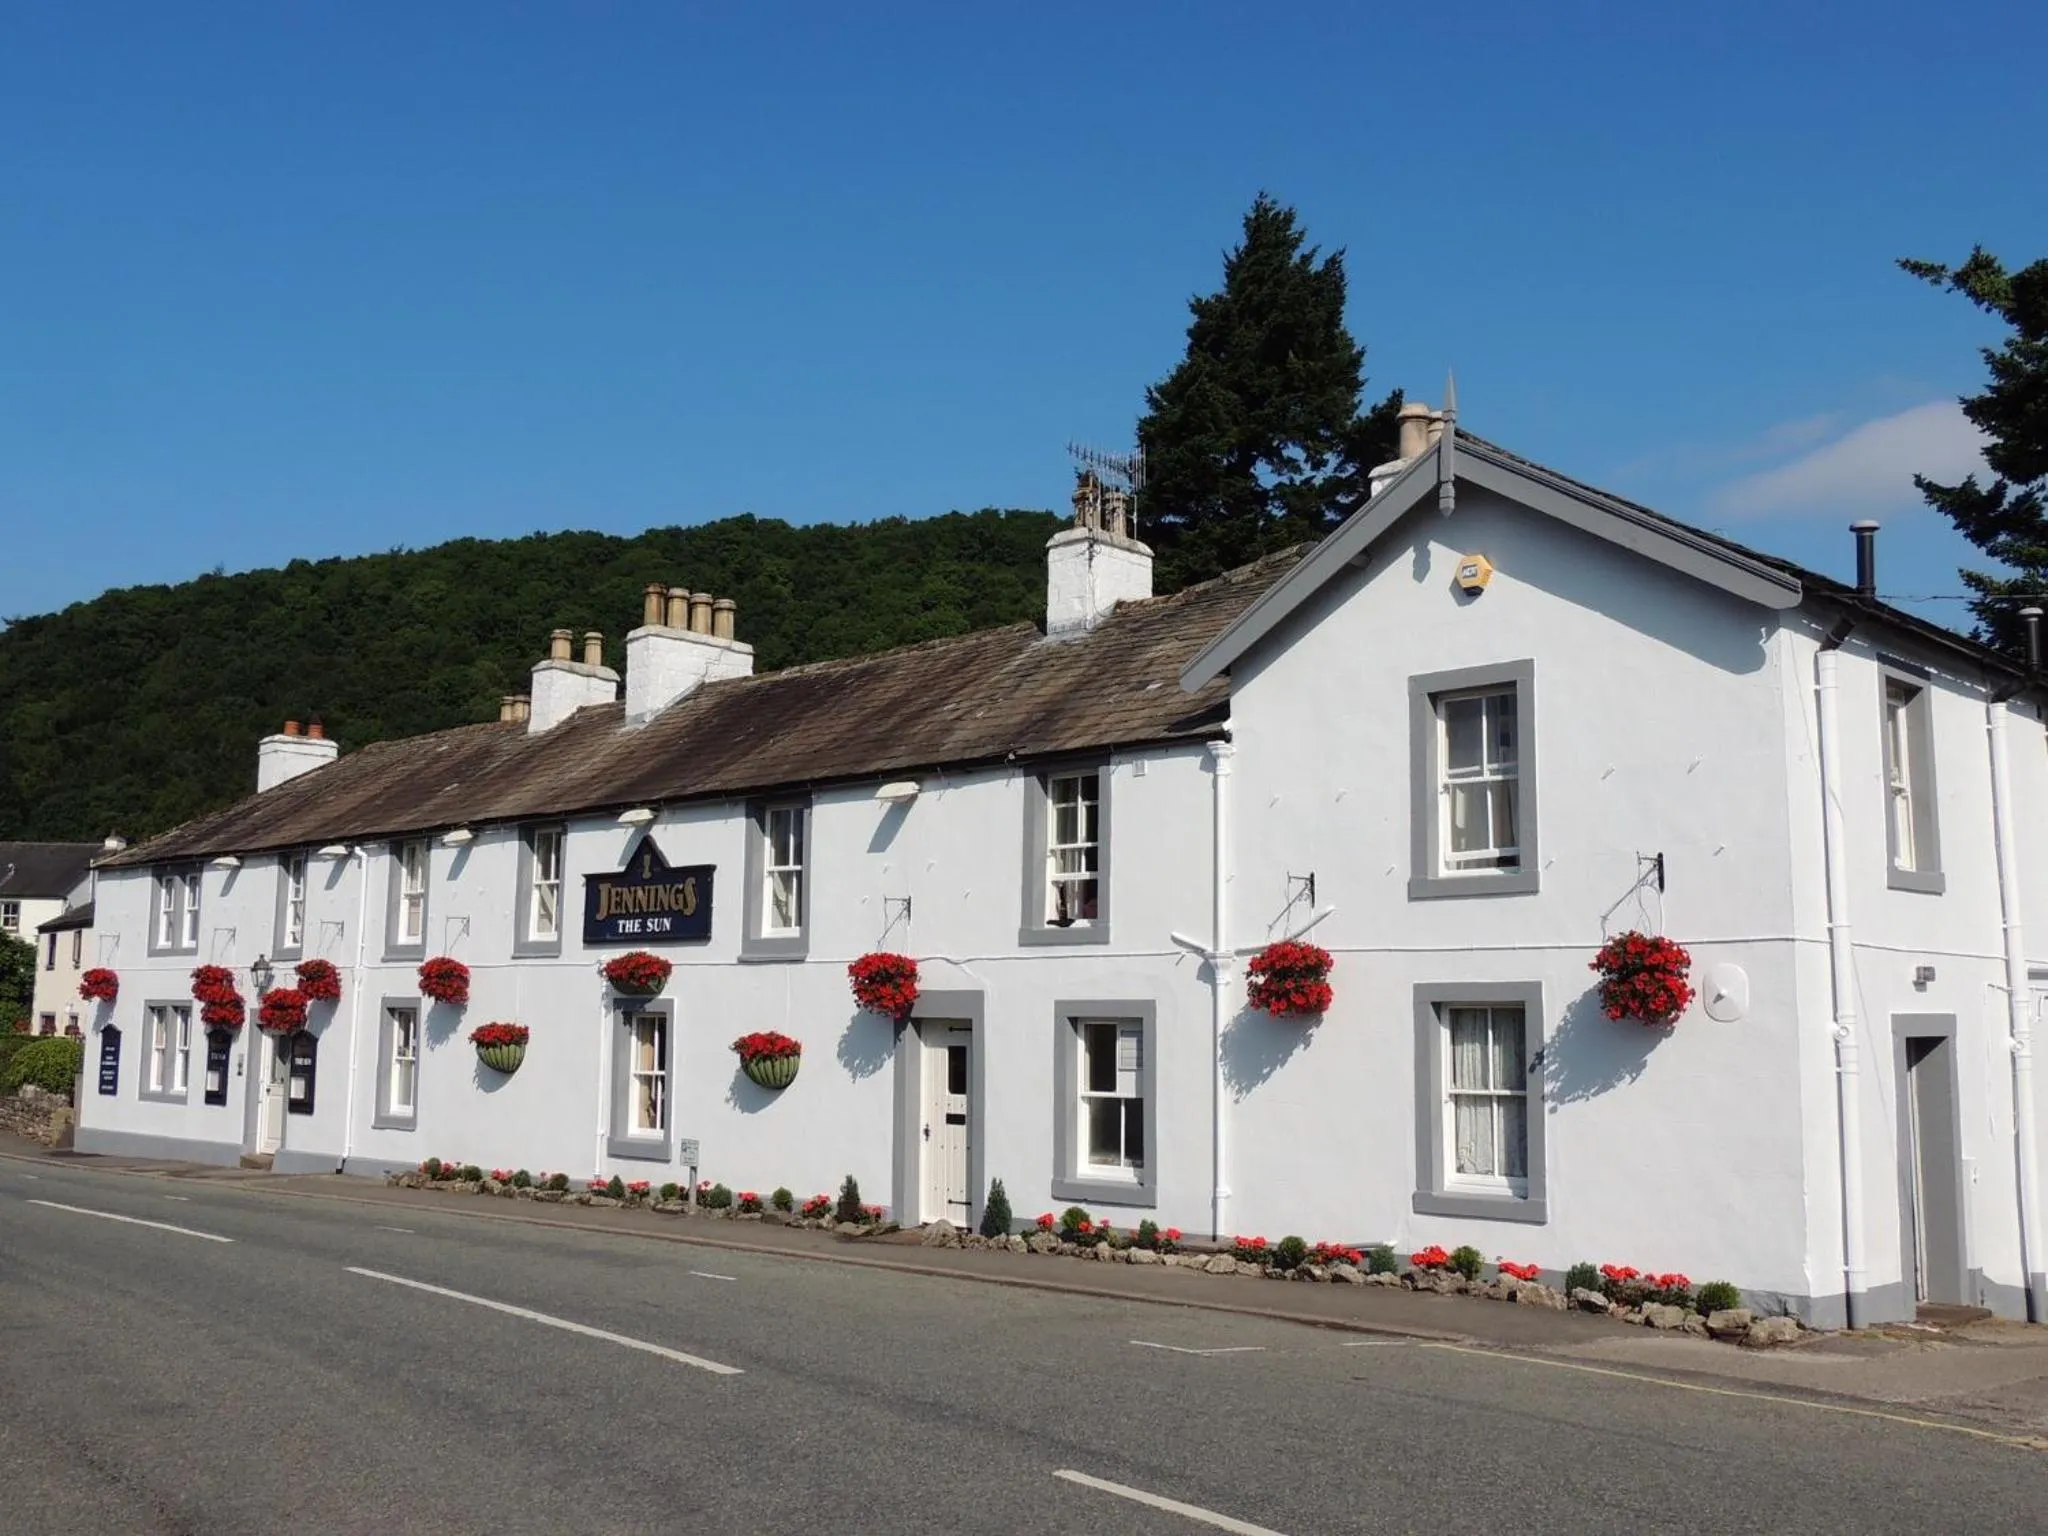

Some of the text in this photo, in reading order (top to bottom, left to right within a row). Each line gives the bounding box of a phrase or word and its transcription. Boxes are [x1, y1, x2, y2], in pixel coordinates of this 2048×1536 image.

[596, 877, 697, 920] JENNINGS
[617, 917, 672, 933] THE SUN
